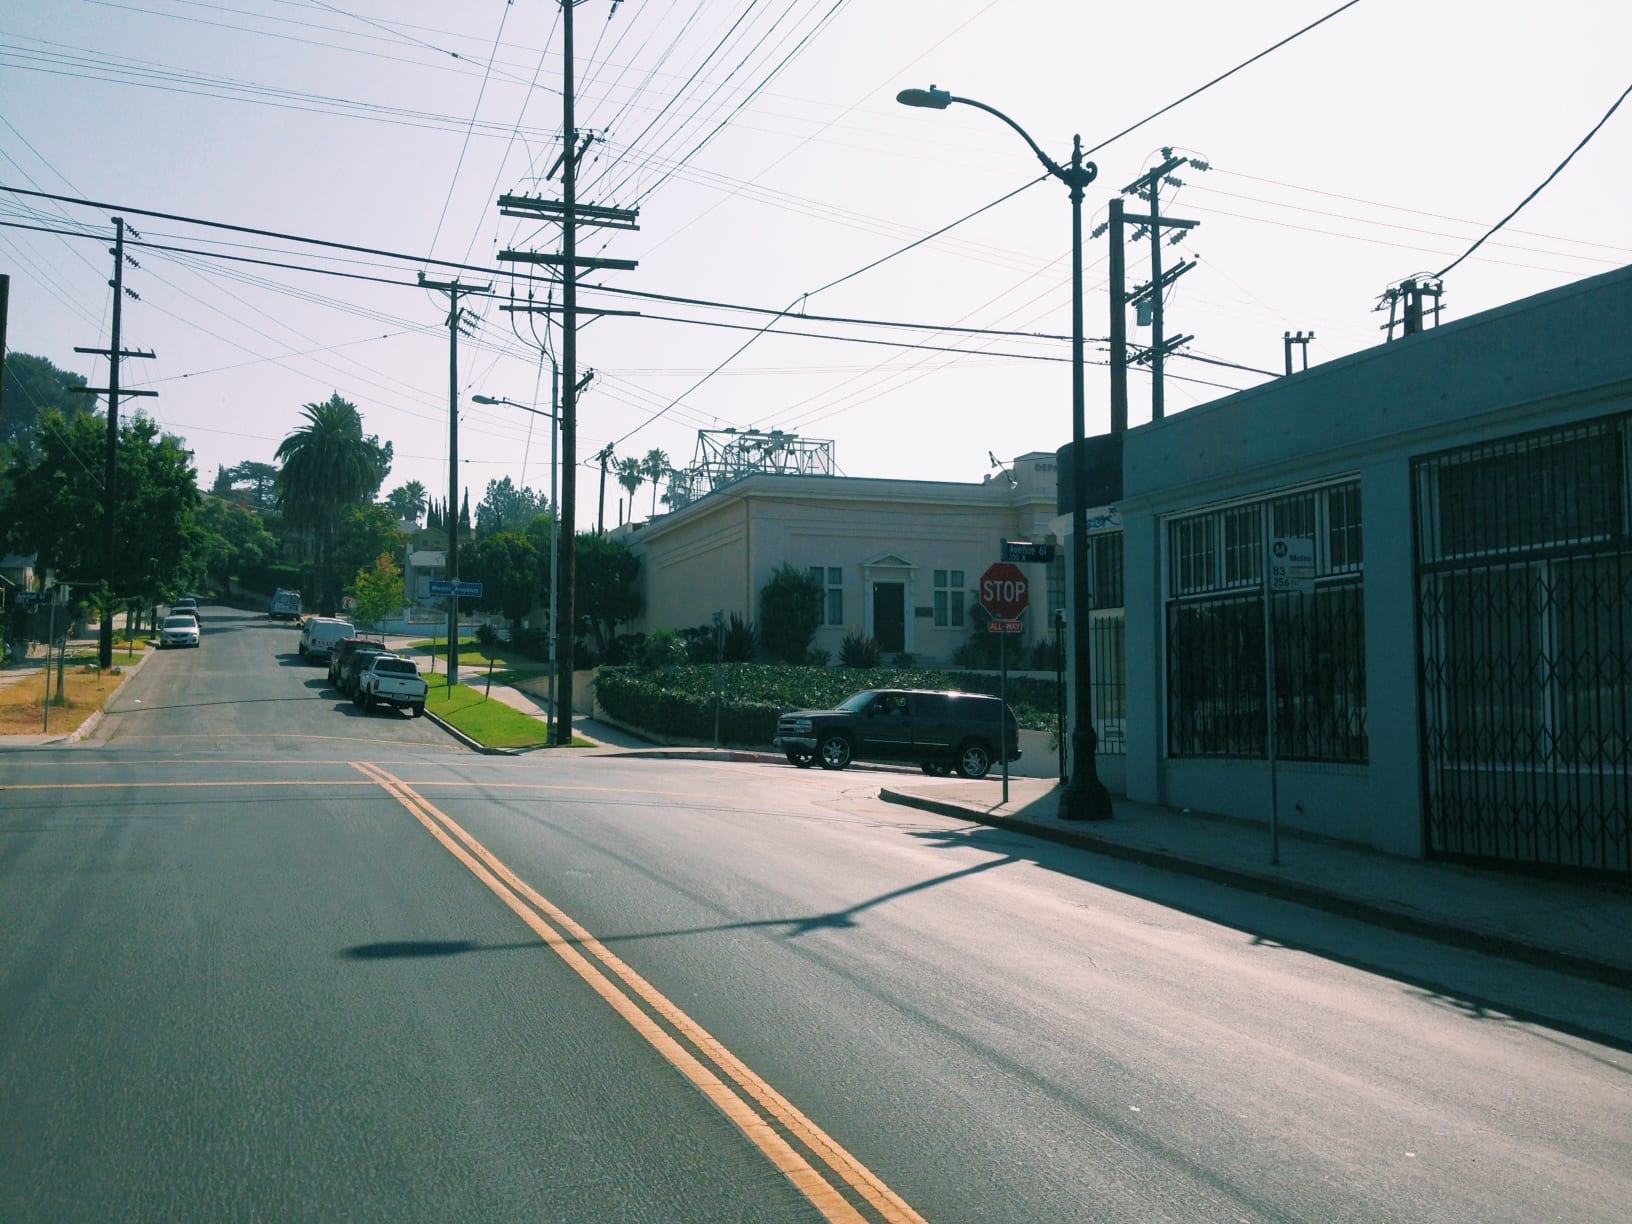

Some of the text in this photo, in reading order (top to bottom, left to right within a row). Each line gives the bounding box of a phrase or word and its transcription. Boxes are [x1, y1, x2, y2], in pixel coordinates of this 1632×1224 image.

[1009, 545, 1047, 556] Avenue 61
[1289, 553, 1312, 561] Metro
[1273, 567, 1285, 576] 83
[983, 580, 1026, 602] STOP
[990, 622, 1021, 631] ALL-WAY
